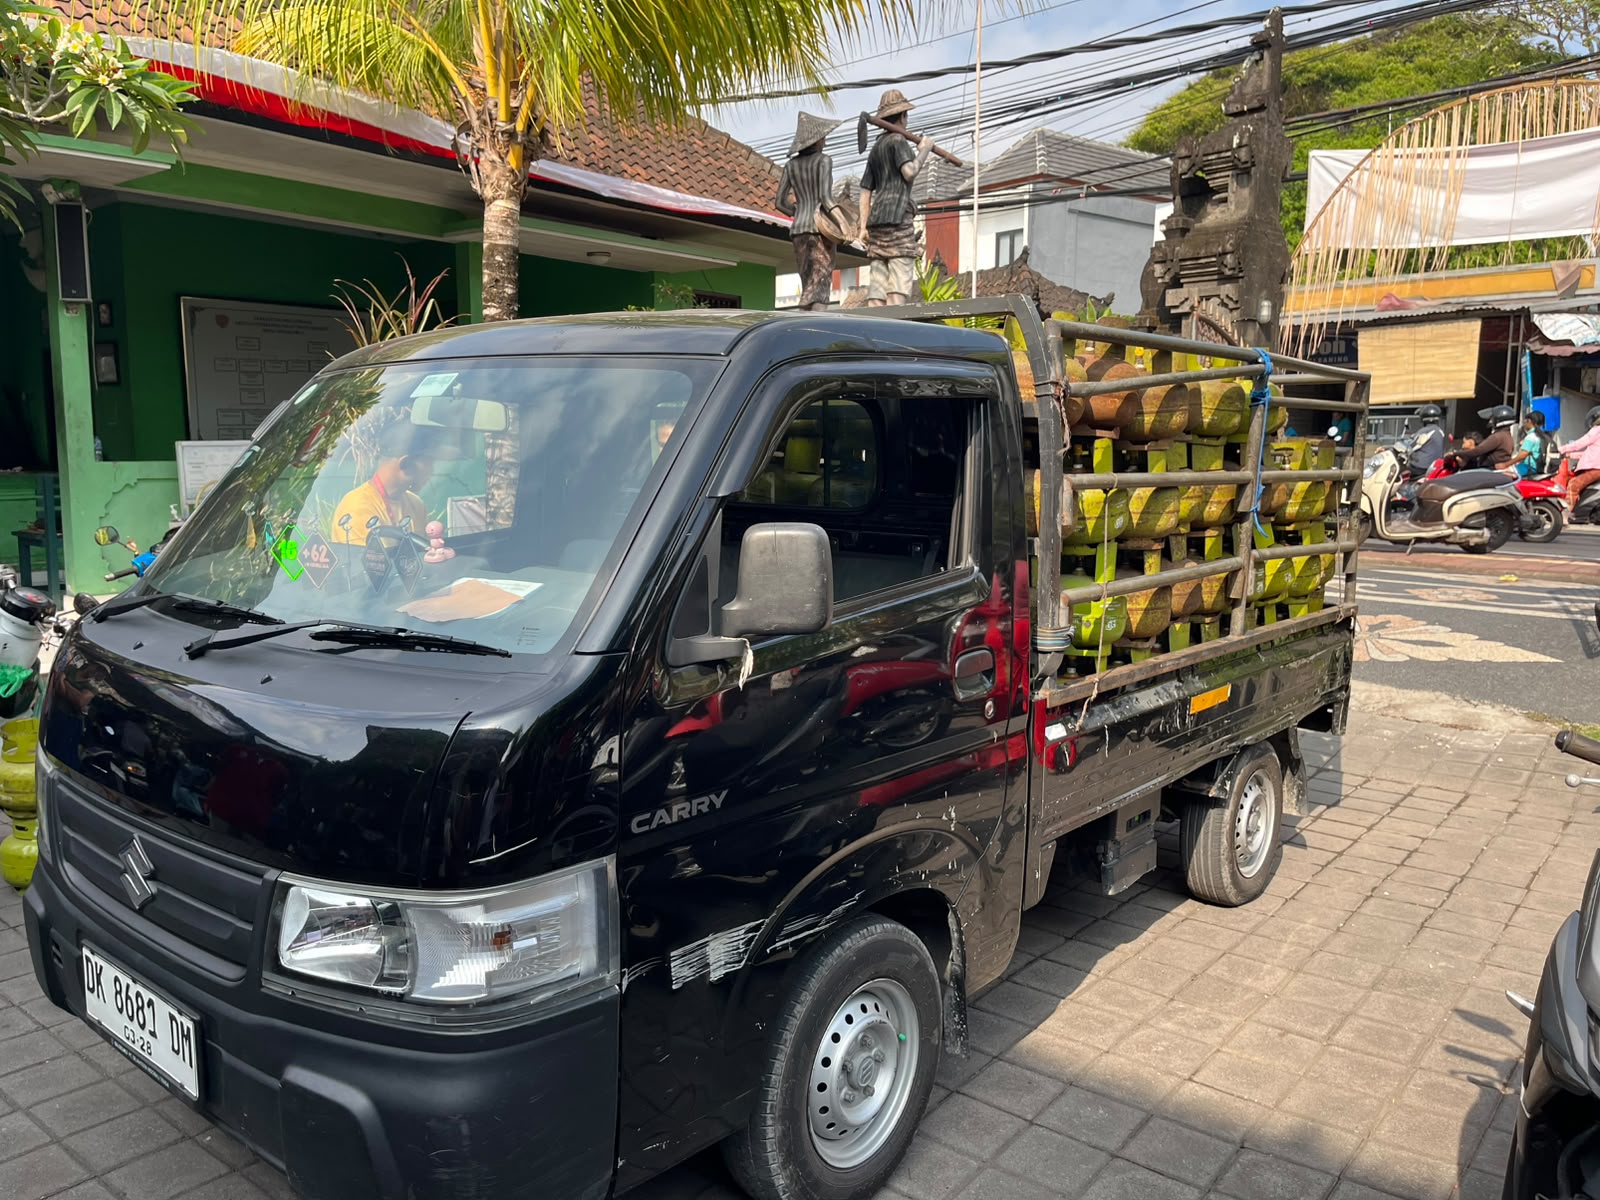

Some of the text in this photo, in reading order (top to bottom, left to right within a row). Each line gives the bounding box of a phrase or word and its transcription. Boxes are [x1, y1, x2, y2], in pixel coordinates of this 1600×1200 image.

[302, 543, 330, 563] +62
[630, 788, 729, 834] CARRY
[85, 953, 107, 1004] DK
[113, 975, 158, 1040] 8681
[168, 1011, 194, 1069] DM
